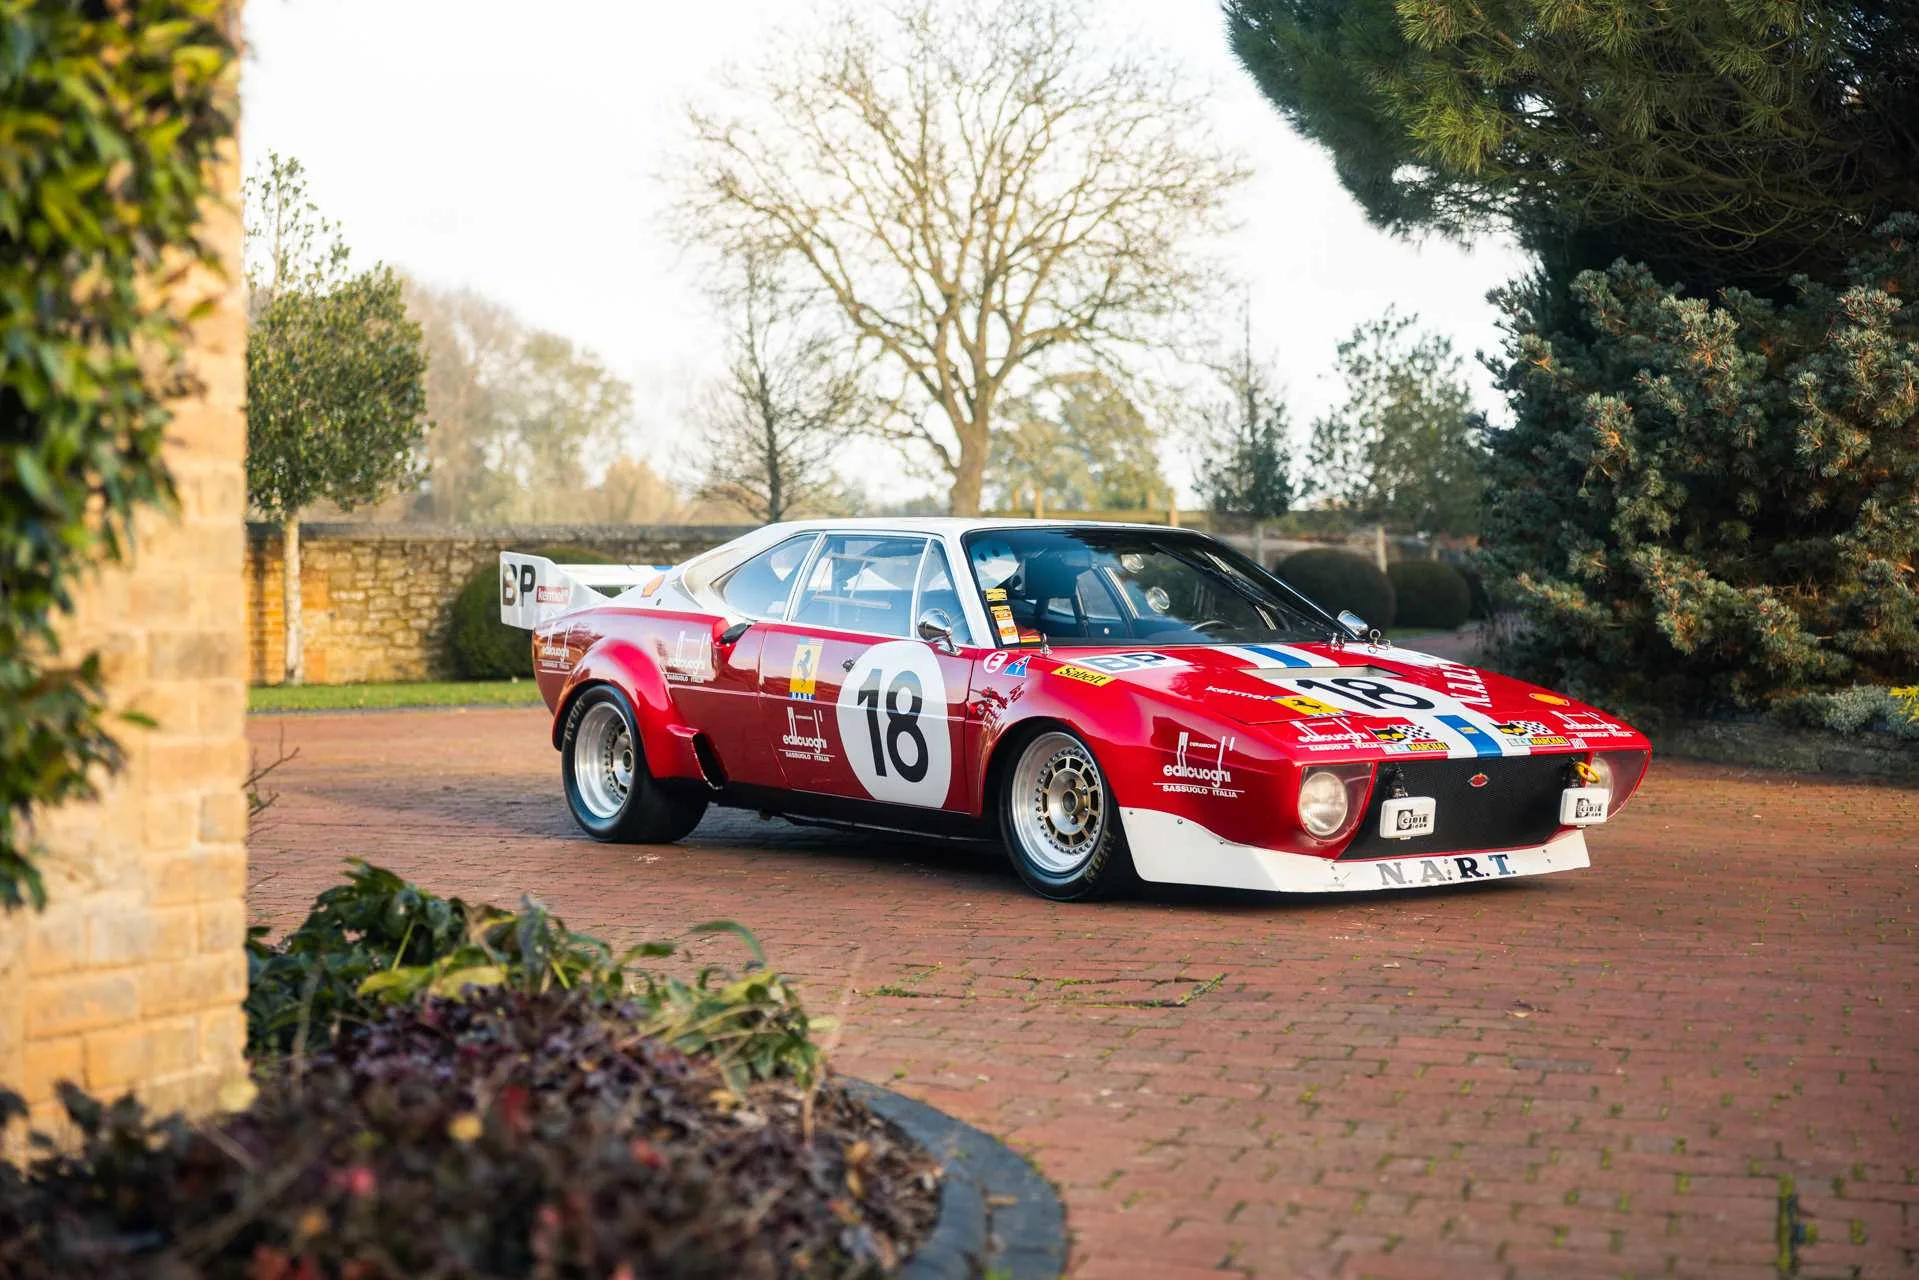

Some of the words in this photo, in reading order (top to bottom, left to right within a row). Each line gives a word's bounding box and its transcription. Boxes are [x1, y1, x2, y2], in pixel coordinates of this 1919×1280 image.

[502, 562, 537, 608] BP
[1059, 664, 1107, 685] Sabelt
[1295, 678, 1436, 710] 18
[857, 668, 929, 783] 18
[1161, 784, 1209, 795] SASSUOLO
[1212, 789, 1239, 799] ITALIA
